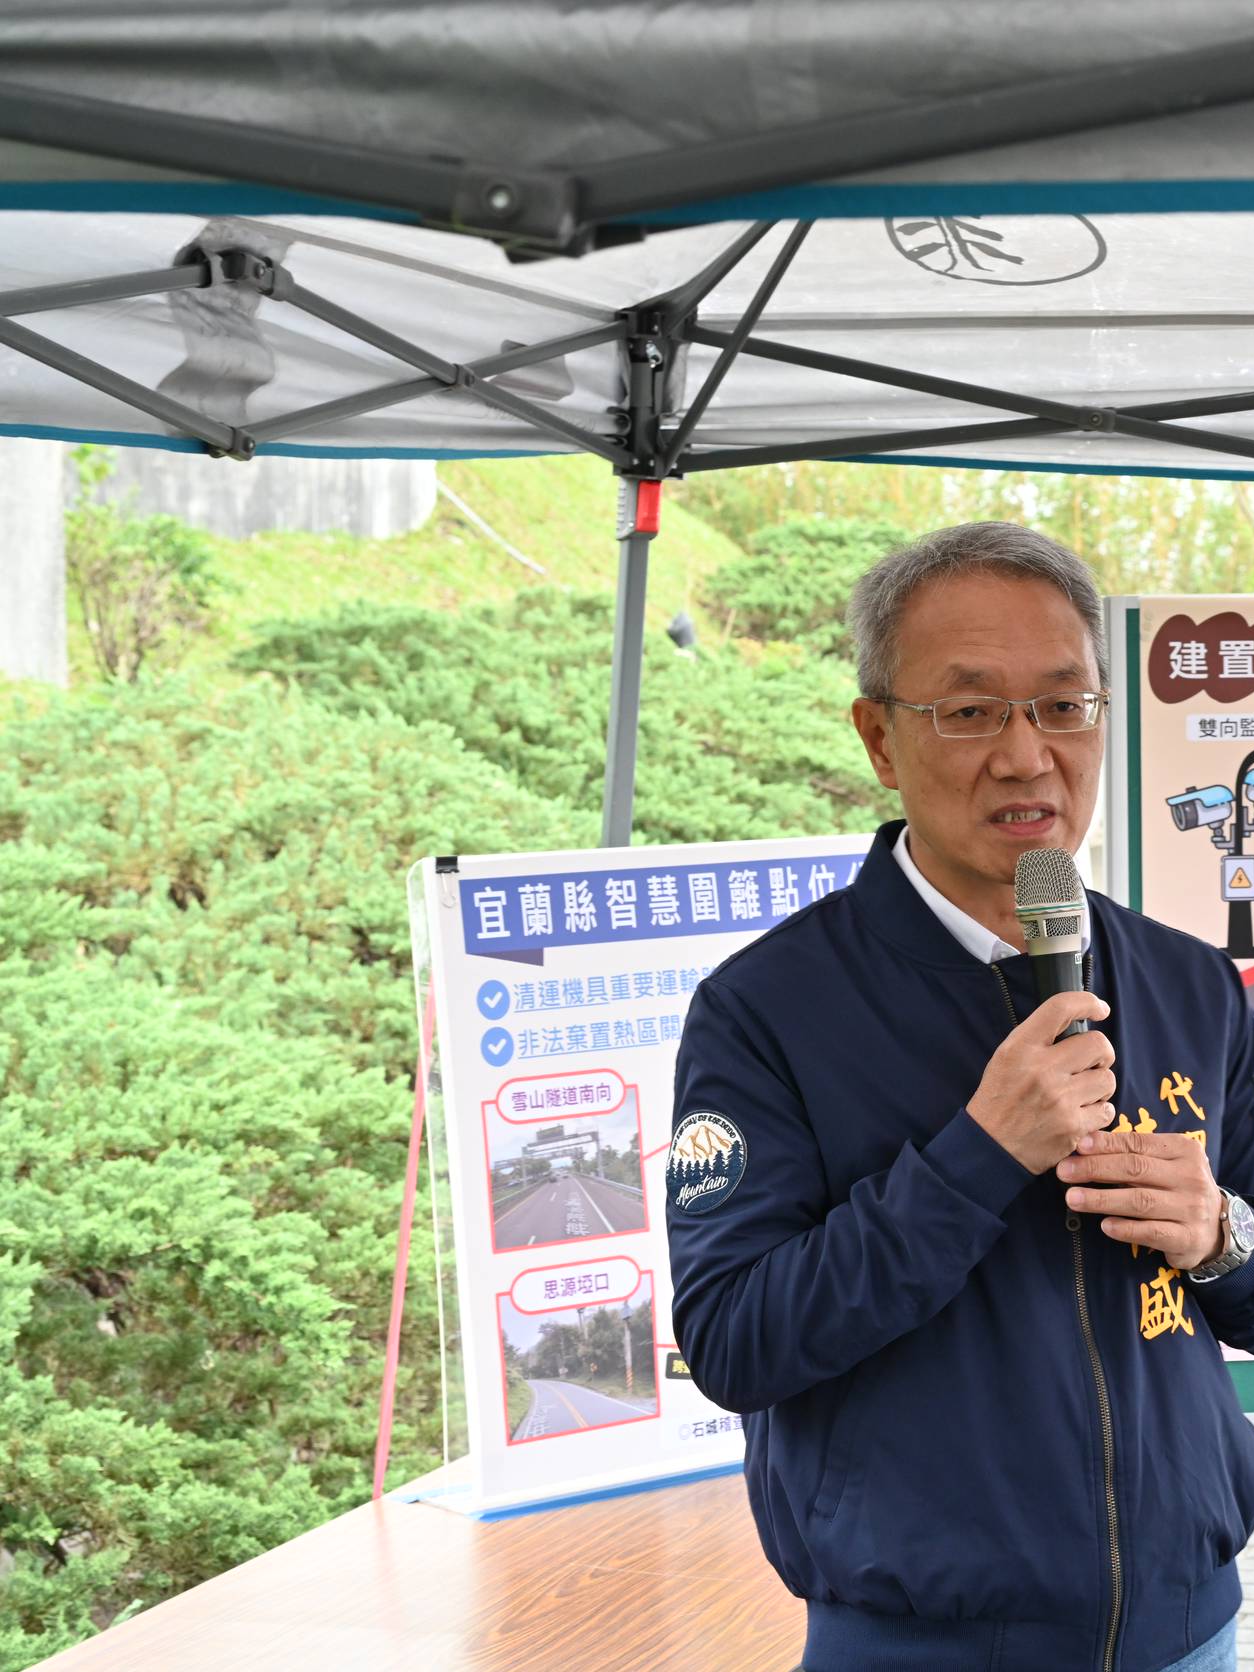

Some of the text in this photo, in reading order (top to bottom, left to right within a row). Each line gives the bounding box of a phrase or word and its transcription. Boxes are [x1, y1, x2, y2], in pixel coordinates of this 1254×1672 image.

[473, 861, 864, 940] 宜蘭縣智慧圍籬點位
[514, 968, 716, 1010] 清運機具重要運輸
[511, 1083, 612, 1113] 雪山隧道南向
[676, 1174, 729, 1207] Mountain
[544, 1273, 609, 1299] 思源埡口
